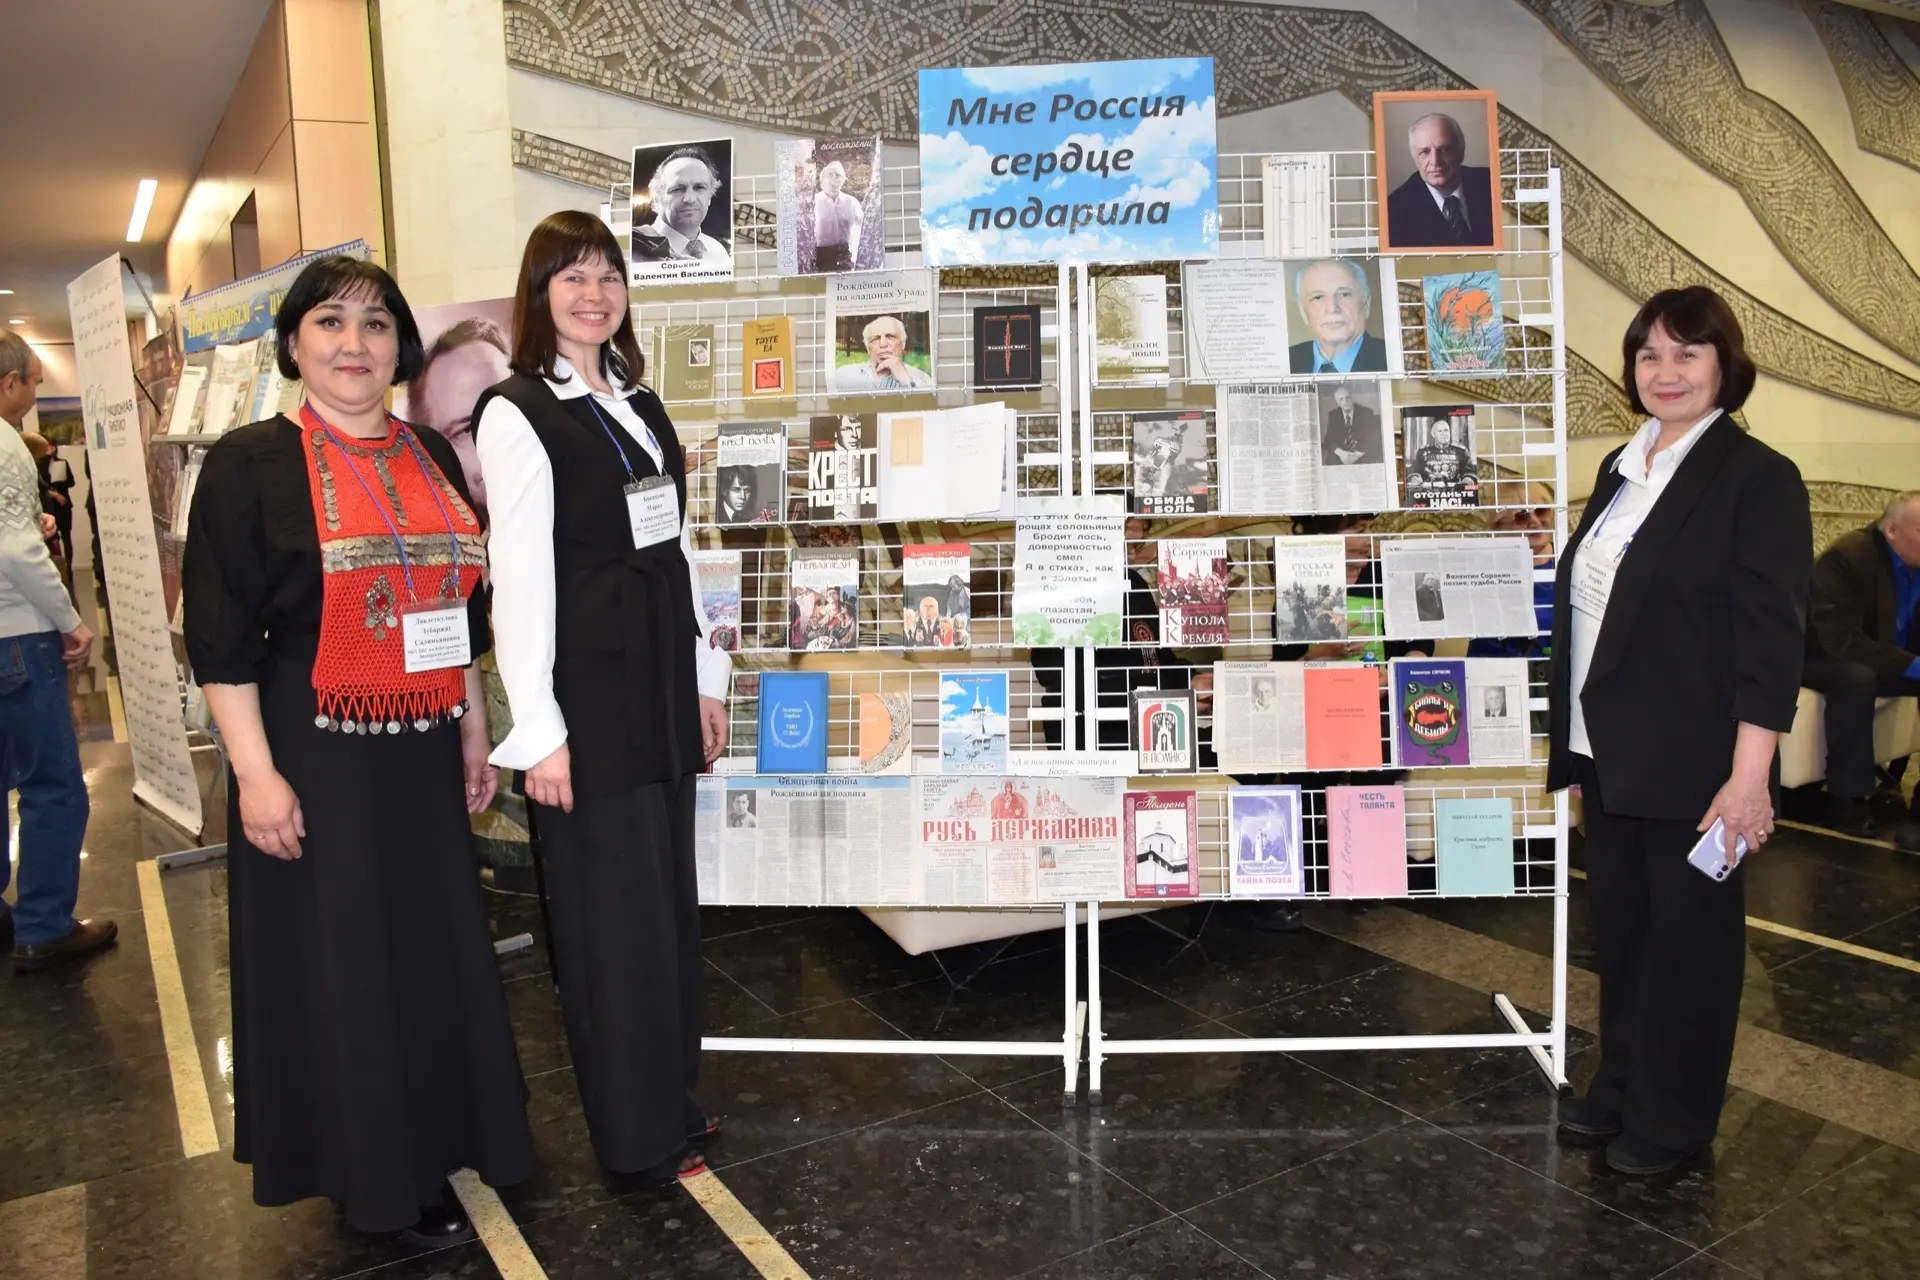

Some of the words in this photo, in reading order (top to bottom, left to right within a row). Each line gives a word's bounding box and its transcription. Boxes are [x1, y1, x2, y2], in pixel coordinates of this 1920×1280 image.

[947, 96, 1036, 126] Мне
[1049, 93, 1186, 123] Россия
[991, 143, 1134, 182] сердце
[967, 197, 1170, 234] подарила
[633, 271, 678, 281] Валентин
[836, 279, 893, 292] Рождённый
[808, 448, 877, 489] КРЕСТ
[808, 487, 877, 507] ПОЭТА
[1413, 490, 1474, 499] ОТСТАНЬТЕ
[1143, 495, 1195, 505] ОБИДА
[1154, 504, 1195, 513] БОЛЬ
[1018, 523, 1052, 531] рощах
[1056, 523, 1122, 531] соловьиных
[1033, 533, 1072, 542] Бродит
[1077, 533, 1107, 541] лось,
[1028, 544, 1112, 552] доверчивостью
[1172, 548, 1224, 559] Сорокин
[1049, 565, 1089, 573] стихах,
[1292, 562, 1334, 570] РУССКАЯ
[1481, 572, 1510, 580] Сорокин
[1414, 723, 1448, 737] ДЕБИЛЫ
[1143, 753, 1149, 764] Я
[1151, 751, 1186, 764] ПОМНЮ
[831, 776, 858, 785] война
[770, 789, 818, 797] Рождённый
[1136, 796, 1186, 810] Полдень
[923, 819, 976, 842] РУСЬ
[991, 816, 1117, 842] ДЕРЖАВНАЯ
[1236, 877, 1264, 885] ТАЙНА
[1265, 876, 1292, 884] ПОЭТА
